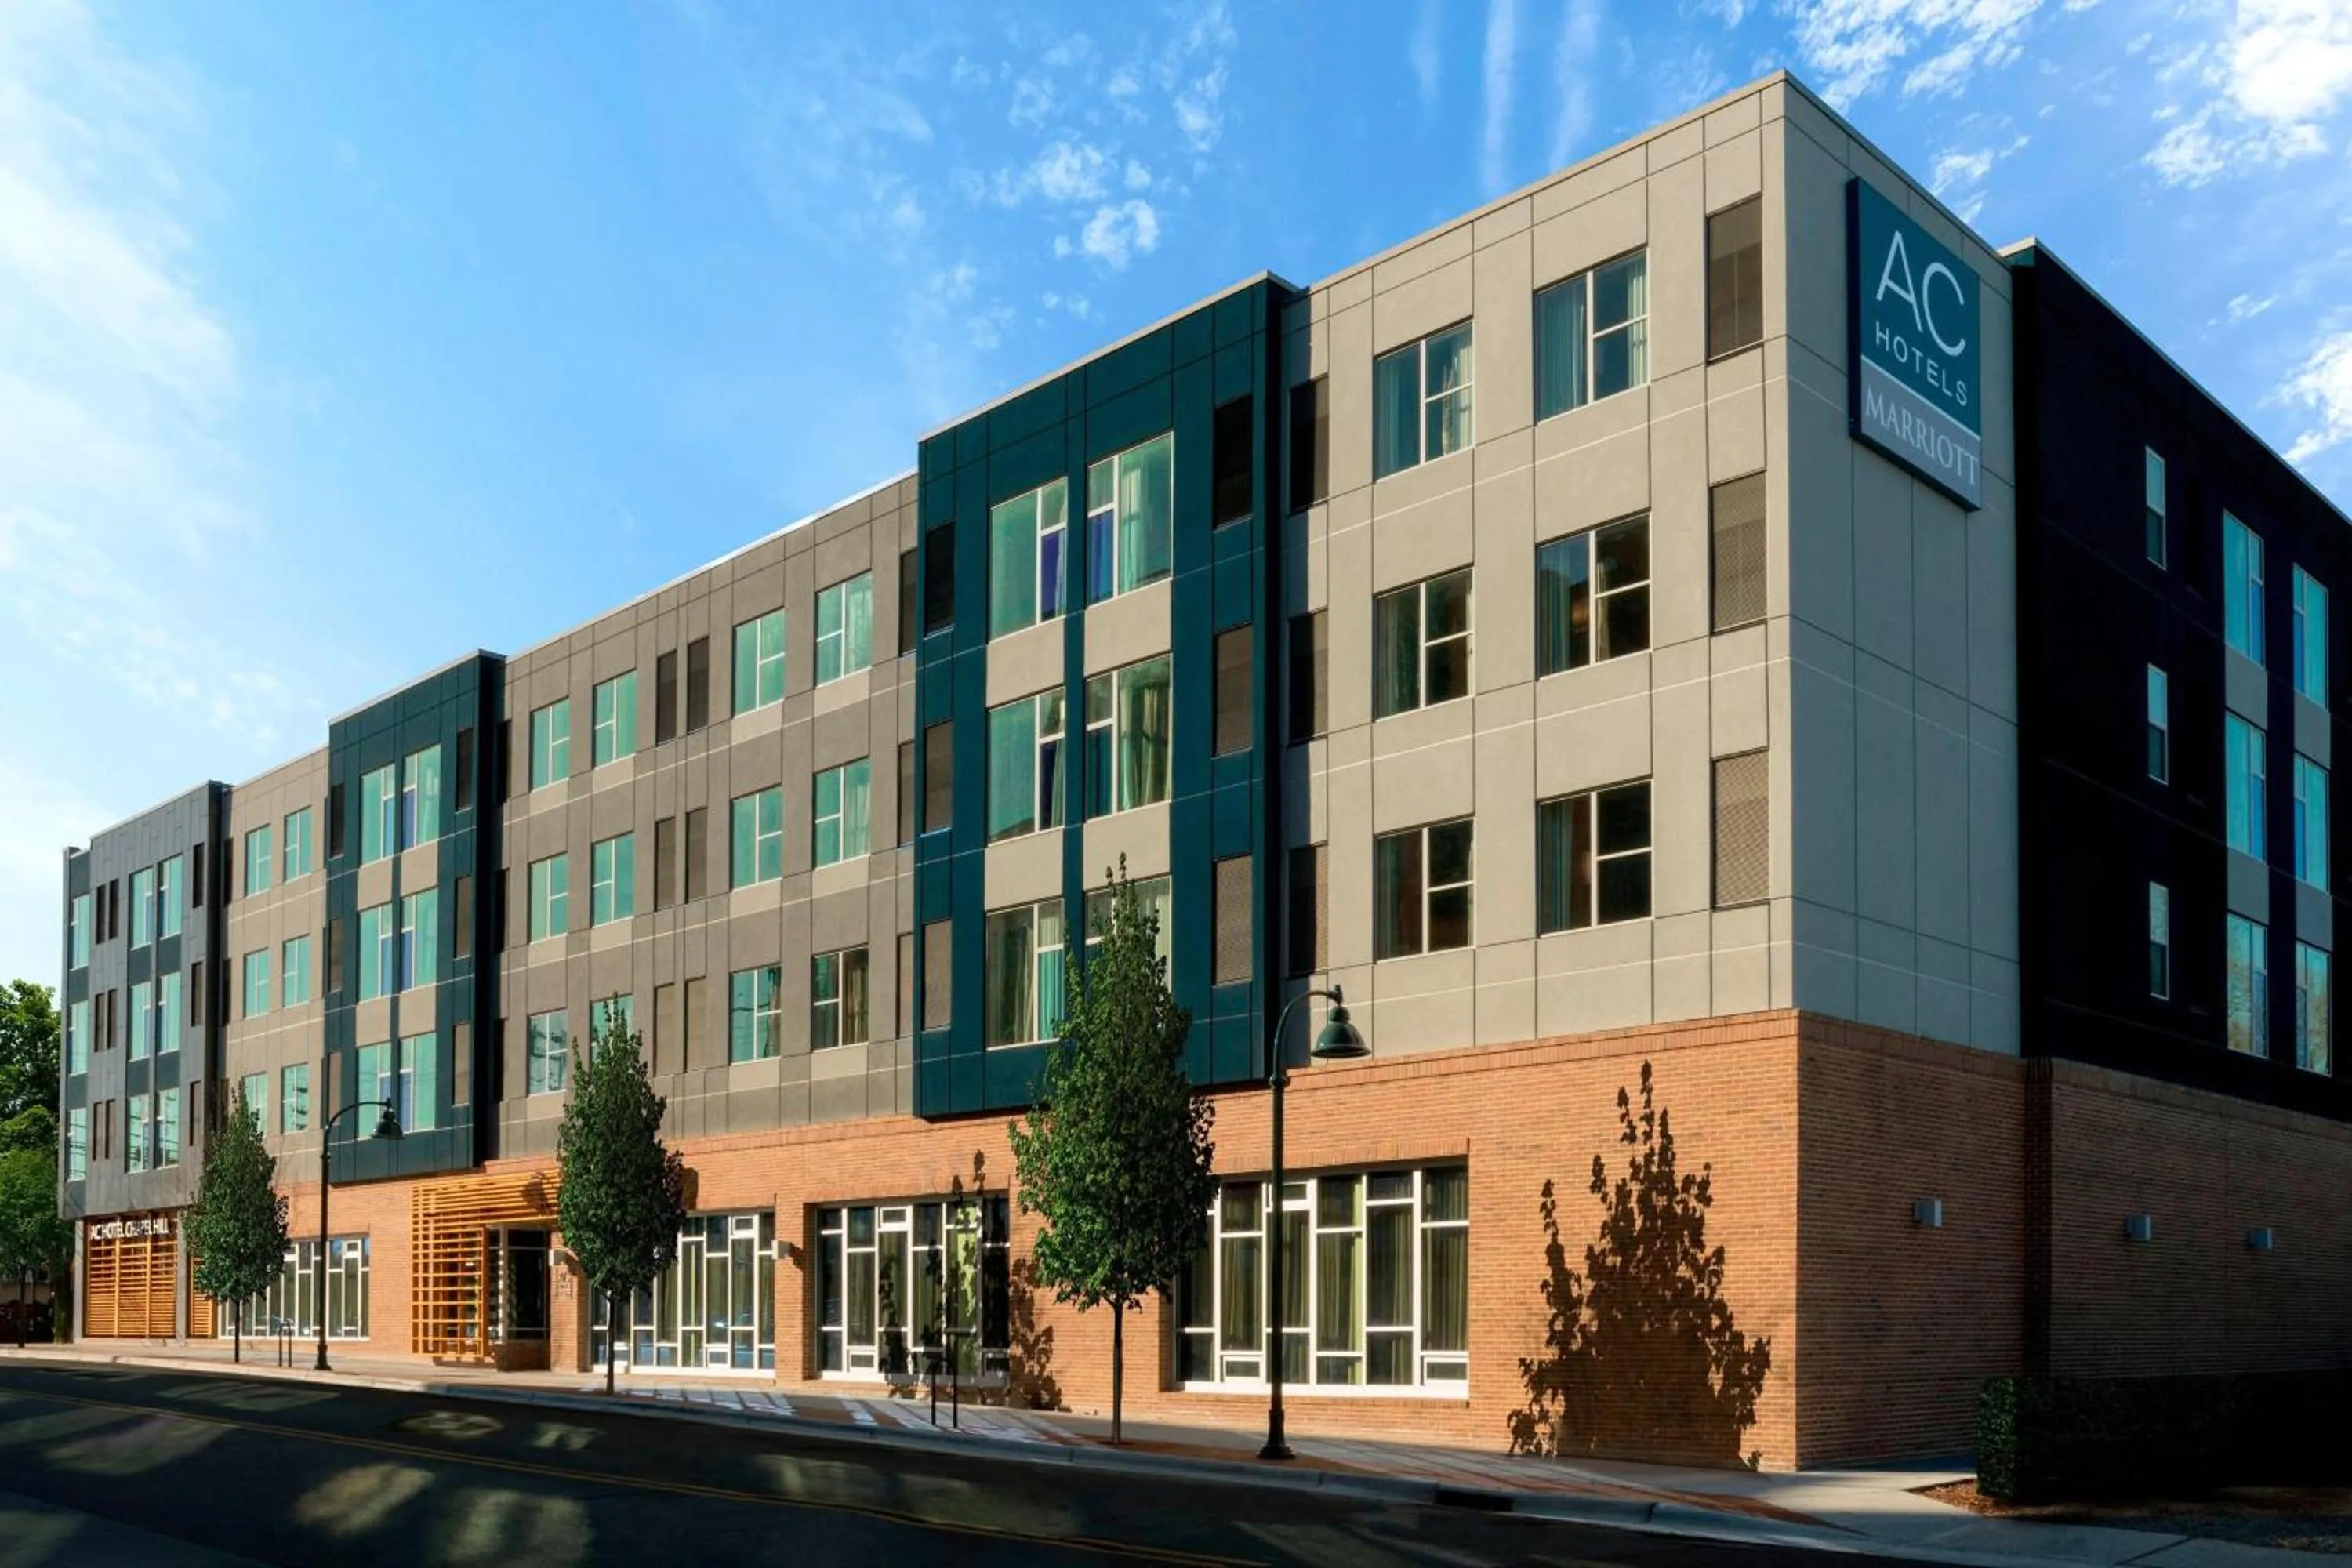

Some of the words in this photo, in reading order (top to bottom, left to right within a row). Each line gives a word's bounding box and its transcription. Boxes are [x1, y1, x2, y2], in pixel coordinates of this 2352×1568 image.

[1876, 230, 1966, 356] AC
[1876, 321, 1968, 406] HOTELS
[1865, 387, 1979, 485] MARRIOTT
[90, 1224, 101, 1240] AC
[101, 1221, 125, 1239] HOTEL
